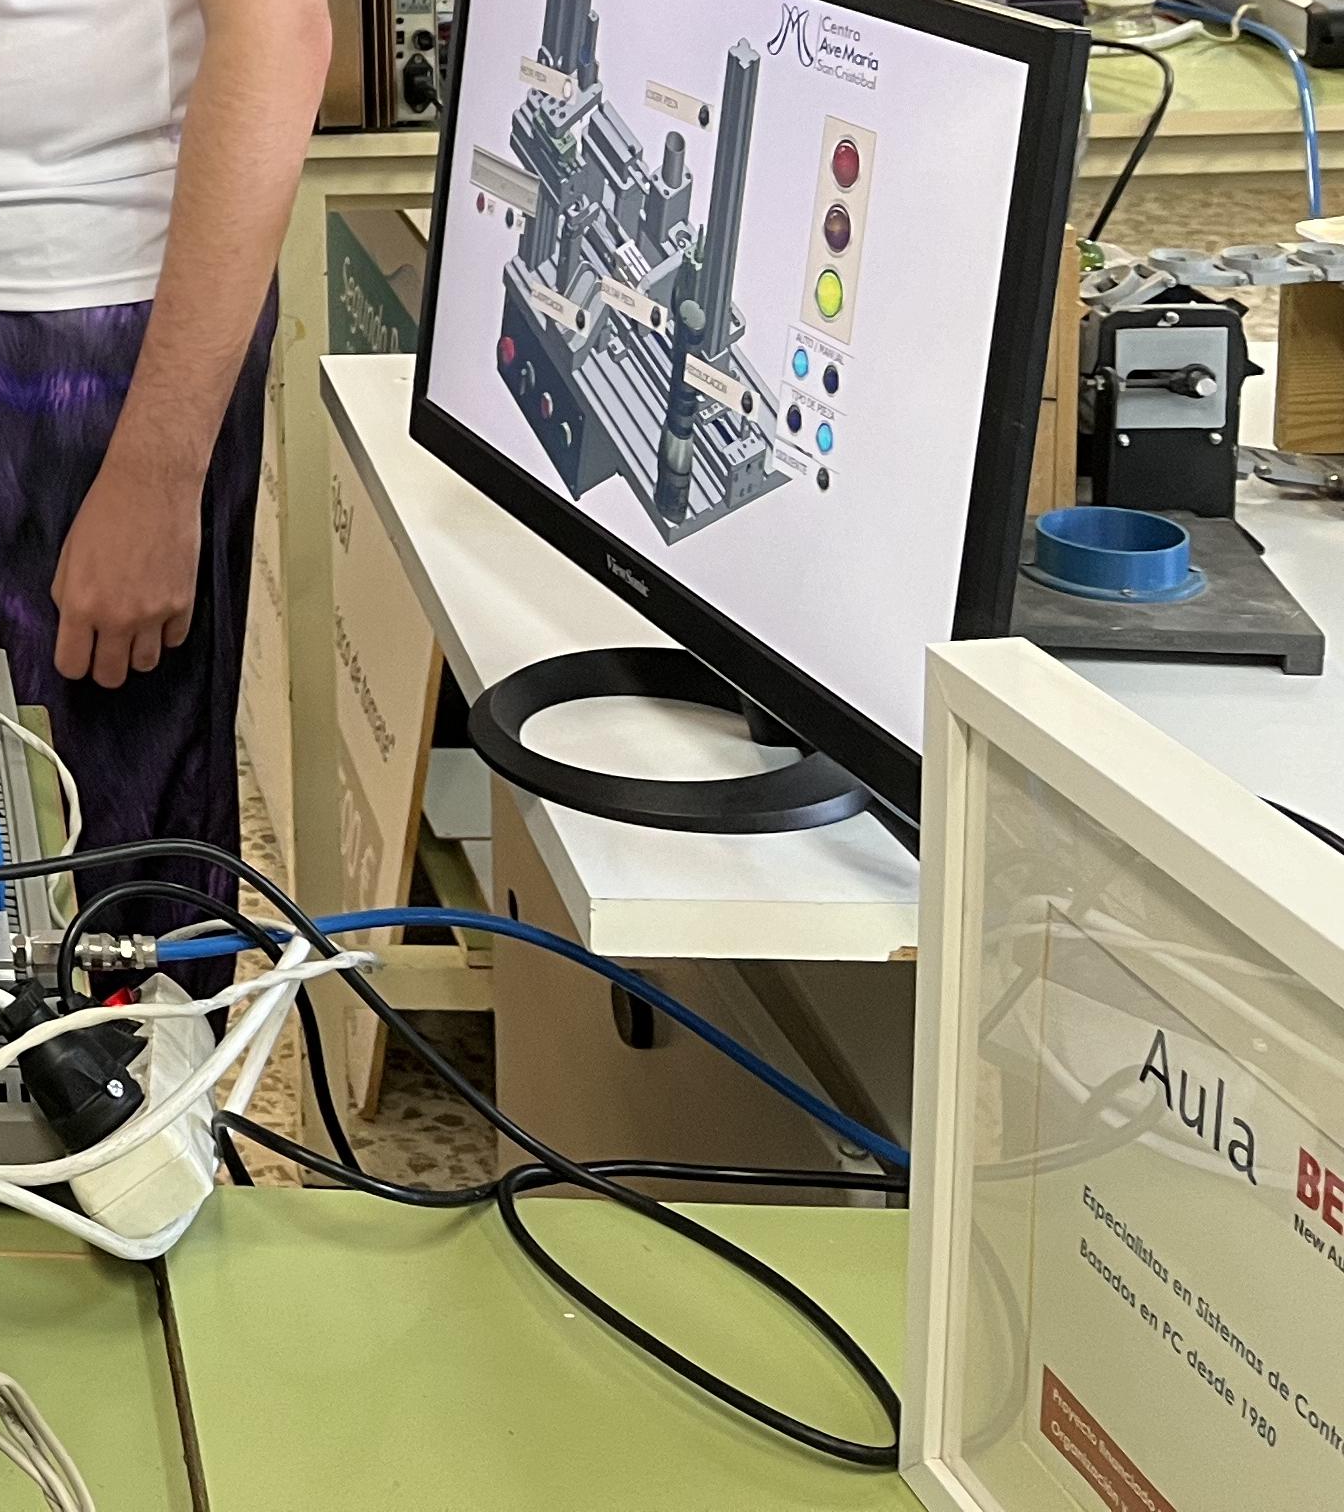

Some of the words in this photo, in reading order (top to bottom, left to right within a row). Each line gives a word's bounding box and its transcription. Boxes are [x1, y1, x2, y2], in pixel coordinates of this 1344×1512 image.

[821, 16, 861, 41] Centro
[1139, 1028, 1258, 1186] Aula
[1293, 1212, 1325, 1254] New
[1079, 1236, 1136, 1308] Basados
[1140, 1303, 1158, 1331] en
[1162, 1320, 1184, 1356] PC
[1186, 1349, 1235, 1406] desde
[1240, 1397, 1277, 1448] 1980
[1082, 1183, 1170, 1284] Especialistas
[1173, 1278, 1192, 1306] en
[1195, 1296, 1264, 1376] Sistemas
[1268, 1370, 1290, 1401] de
[1294, 1393, 1344, 1456] Contr
